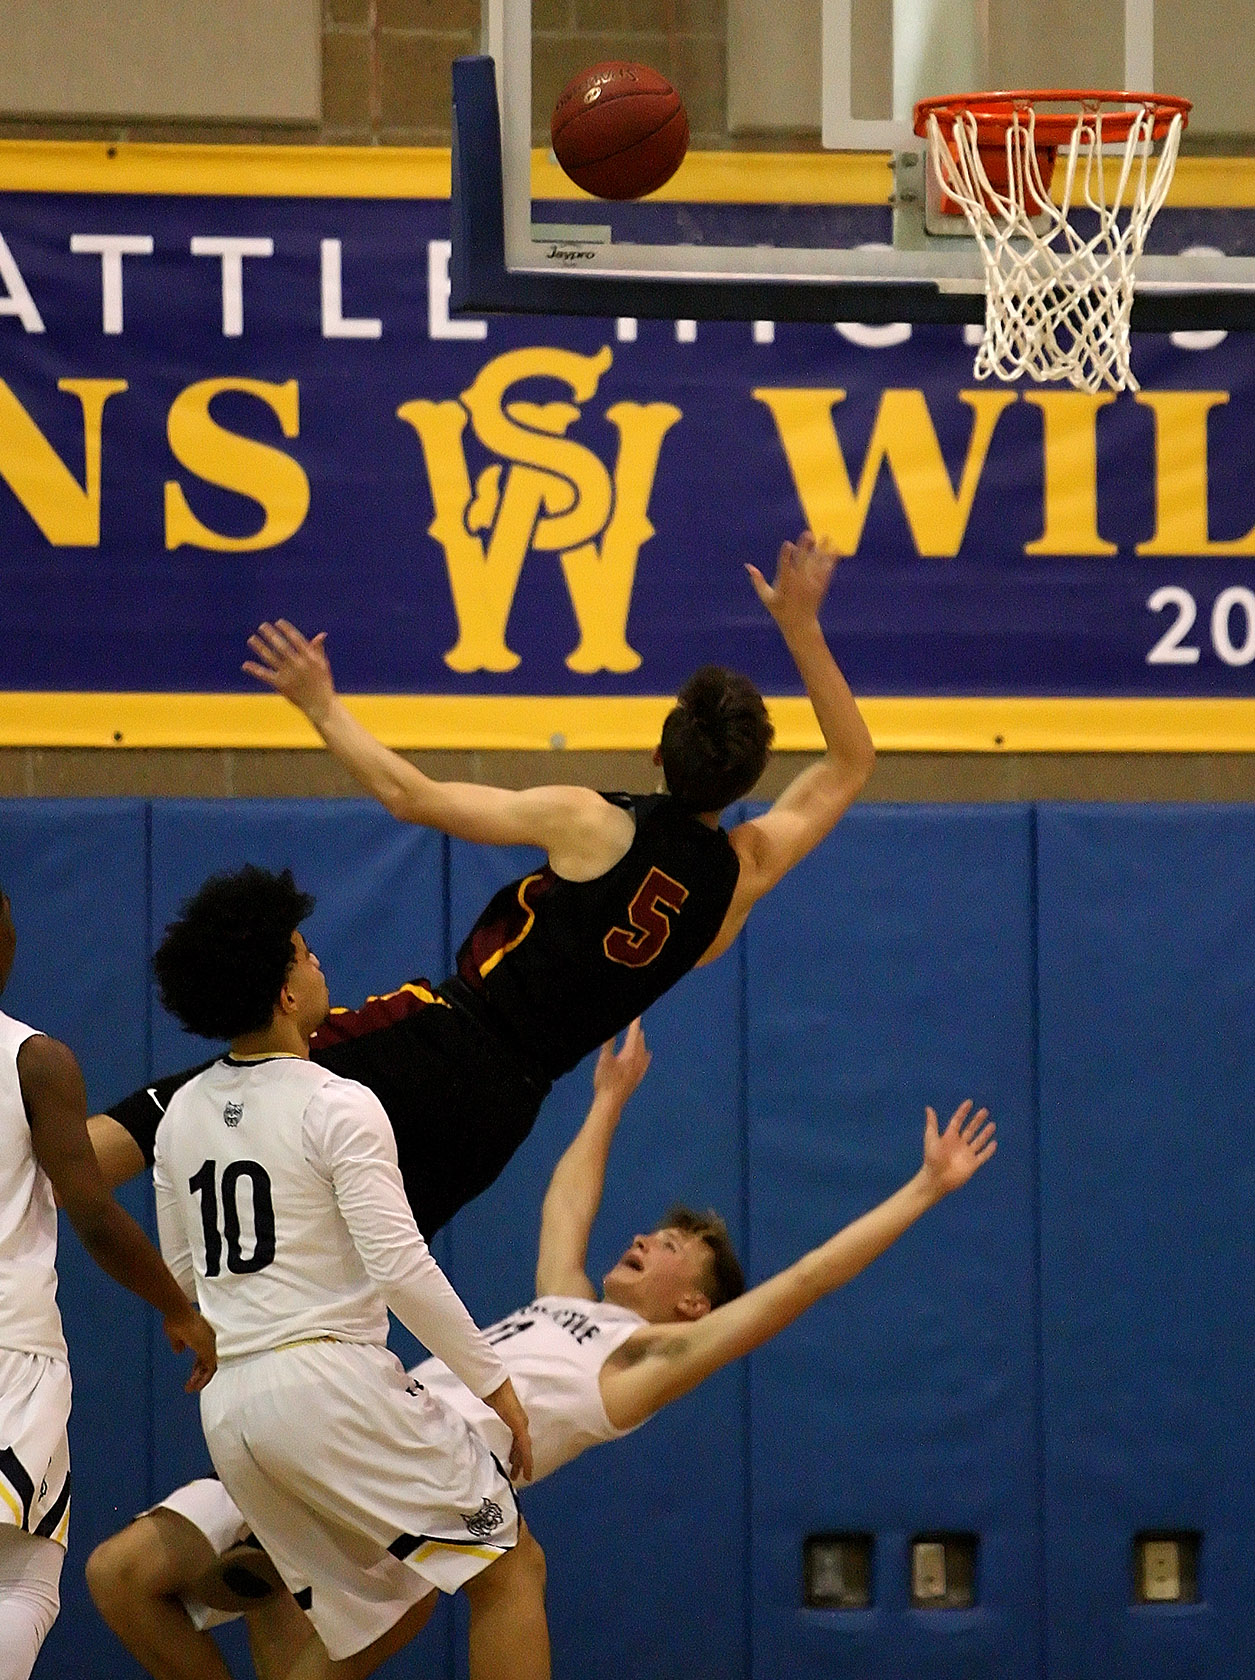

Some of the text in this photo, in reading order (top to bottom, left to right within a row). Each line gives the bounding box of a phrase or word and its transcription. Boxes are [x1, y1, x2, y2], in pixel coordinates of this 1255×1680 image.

[547, 245, 595, 260] Jaypro
[0, 376, 310, 552] NS
[752, 388, 1255, 557] WIL
[1146, 585, 1255, 667] 20
[603, 866, 689, 968] 5
[189, 1159, 276, 1277] 10
